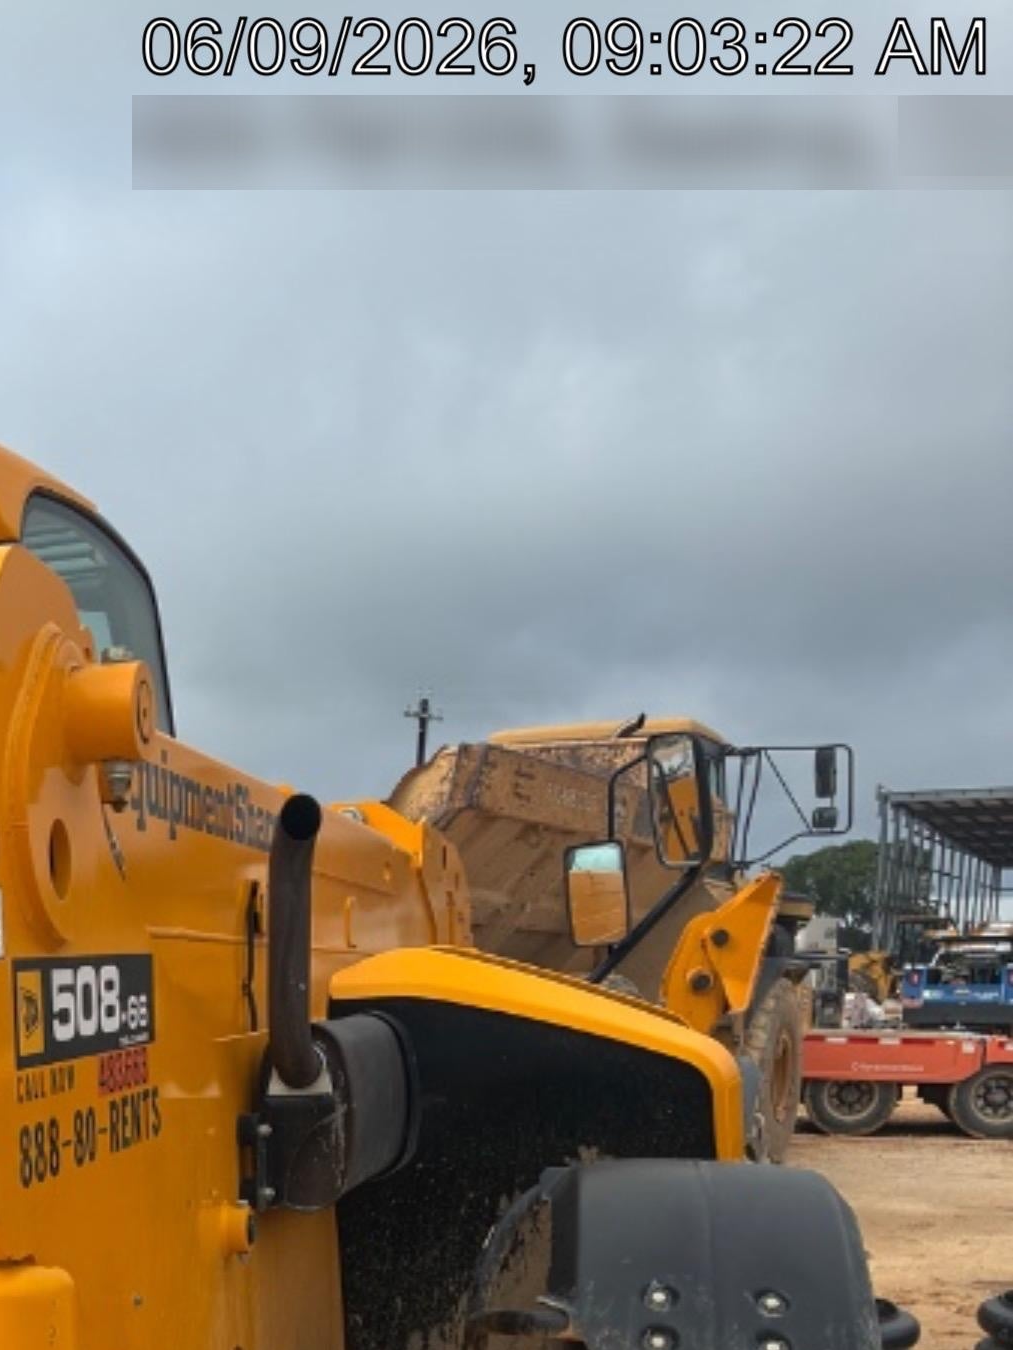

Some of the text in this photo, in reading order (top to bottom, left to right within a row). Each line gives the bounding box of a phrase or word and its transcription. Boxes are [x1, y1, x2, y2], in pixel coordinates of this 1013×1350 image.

[16, 1064, 75, 1104] CALL NOW
[19, 1086, 161, 1189] 888-80-RENTS
